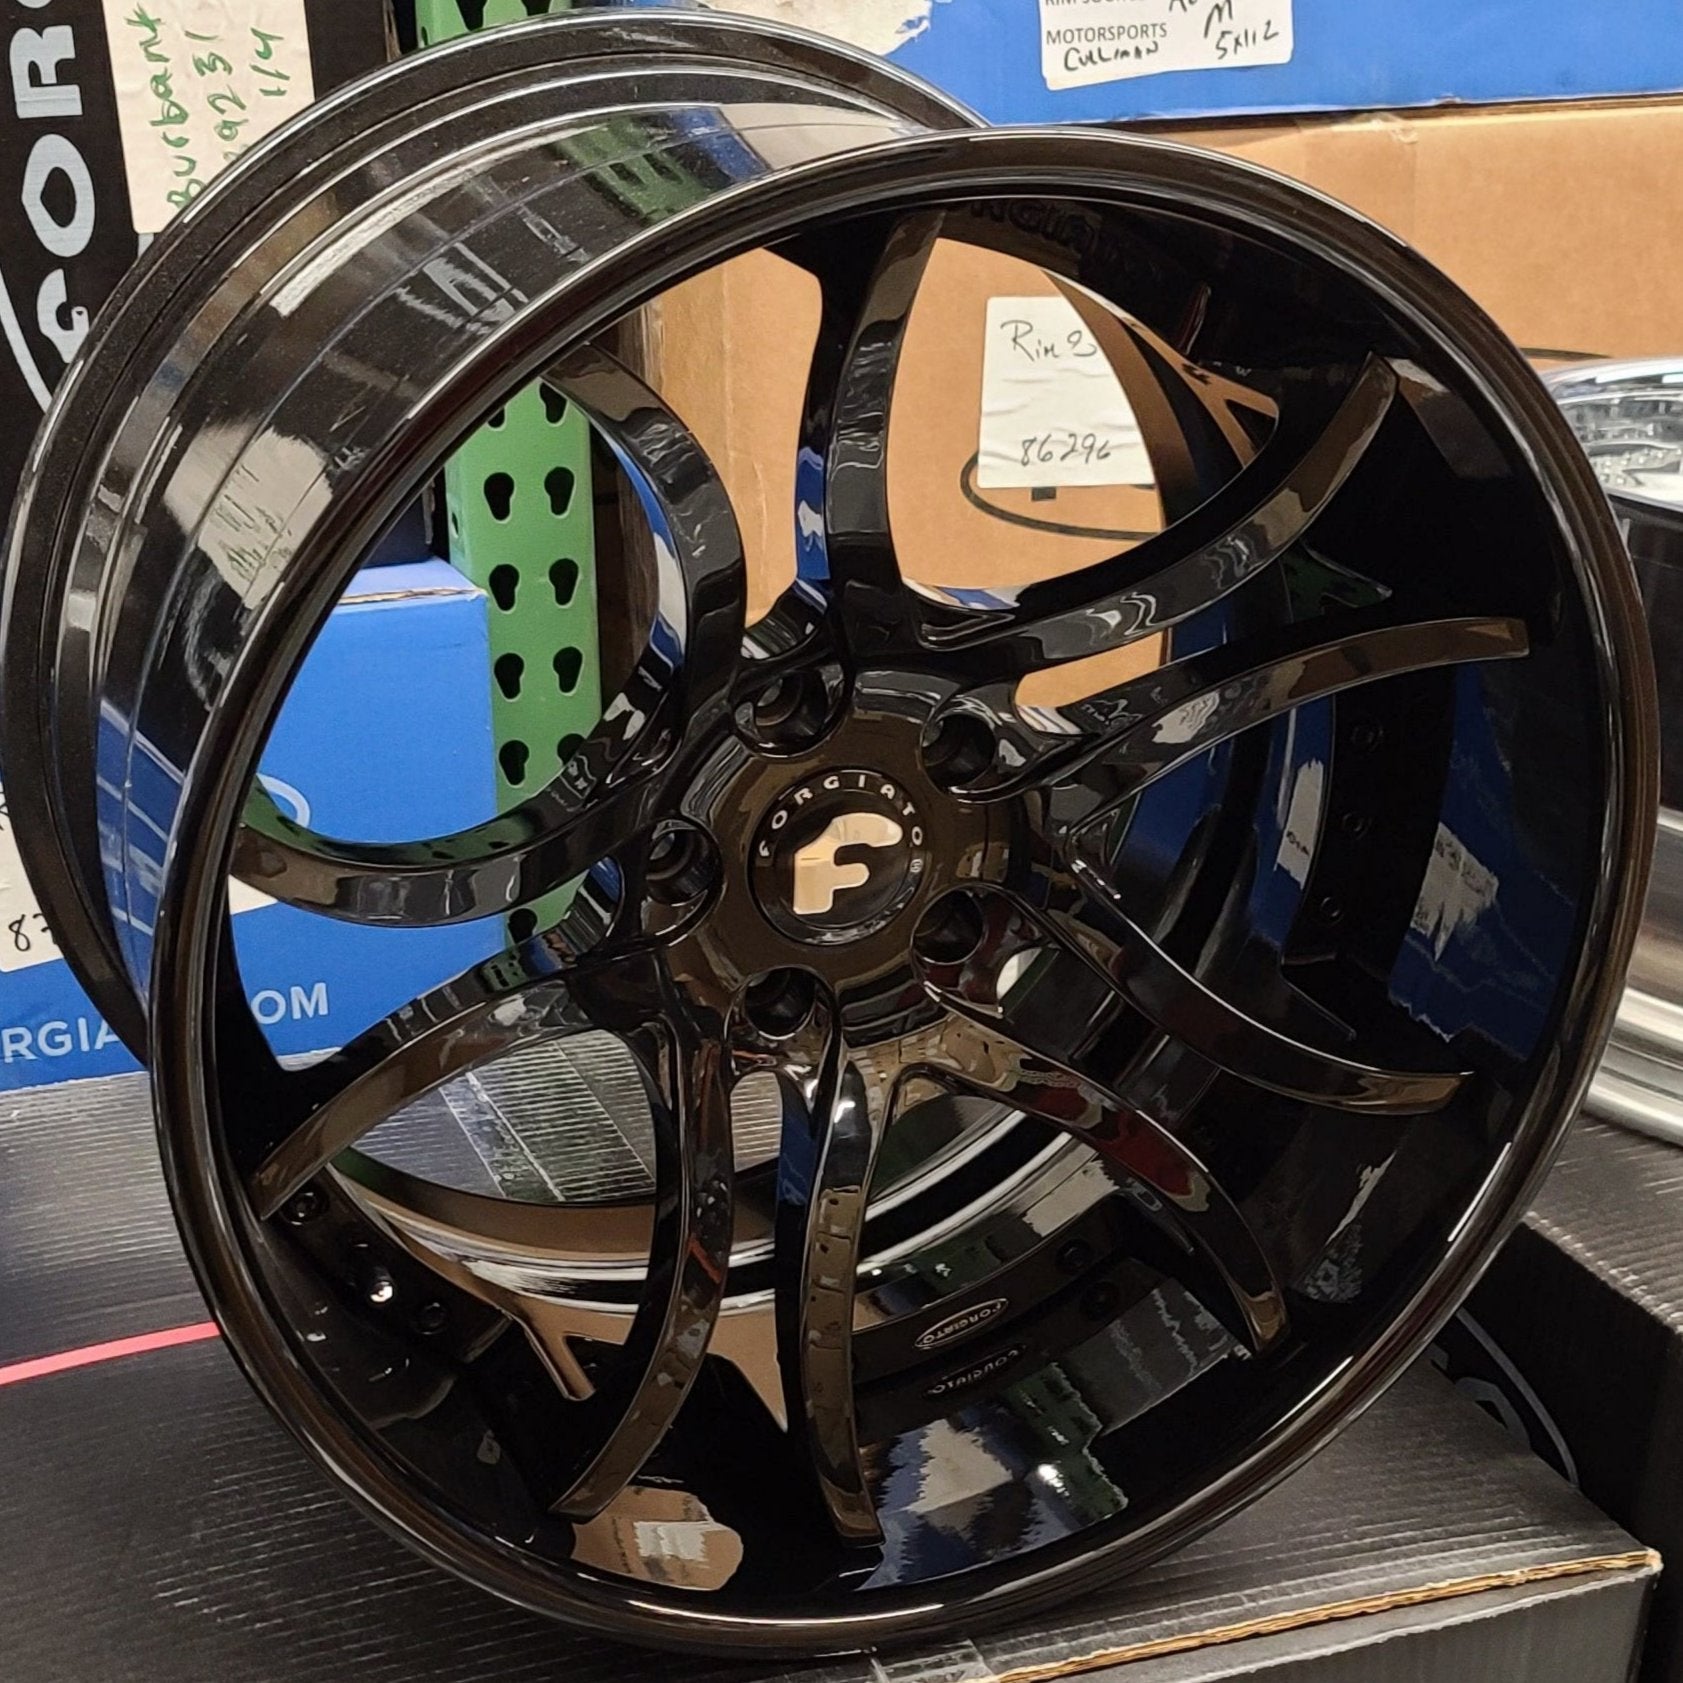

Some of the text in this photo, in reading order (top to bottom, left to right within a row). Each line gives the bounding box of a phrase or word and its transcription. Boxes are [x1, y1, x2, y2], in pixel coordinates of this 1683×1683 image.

[1046, 23, 1168, 45] MOTORSPORTS
[9, 0, 96, 364] FOR
[1020, 432, 1112, 467] 86296
[758, 774, 923, 858] FORGIATO
